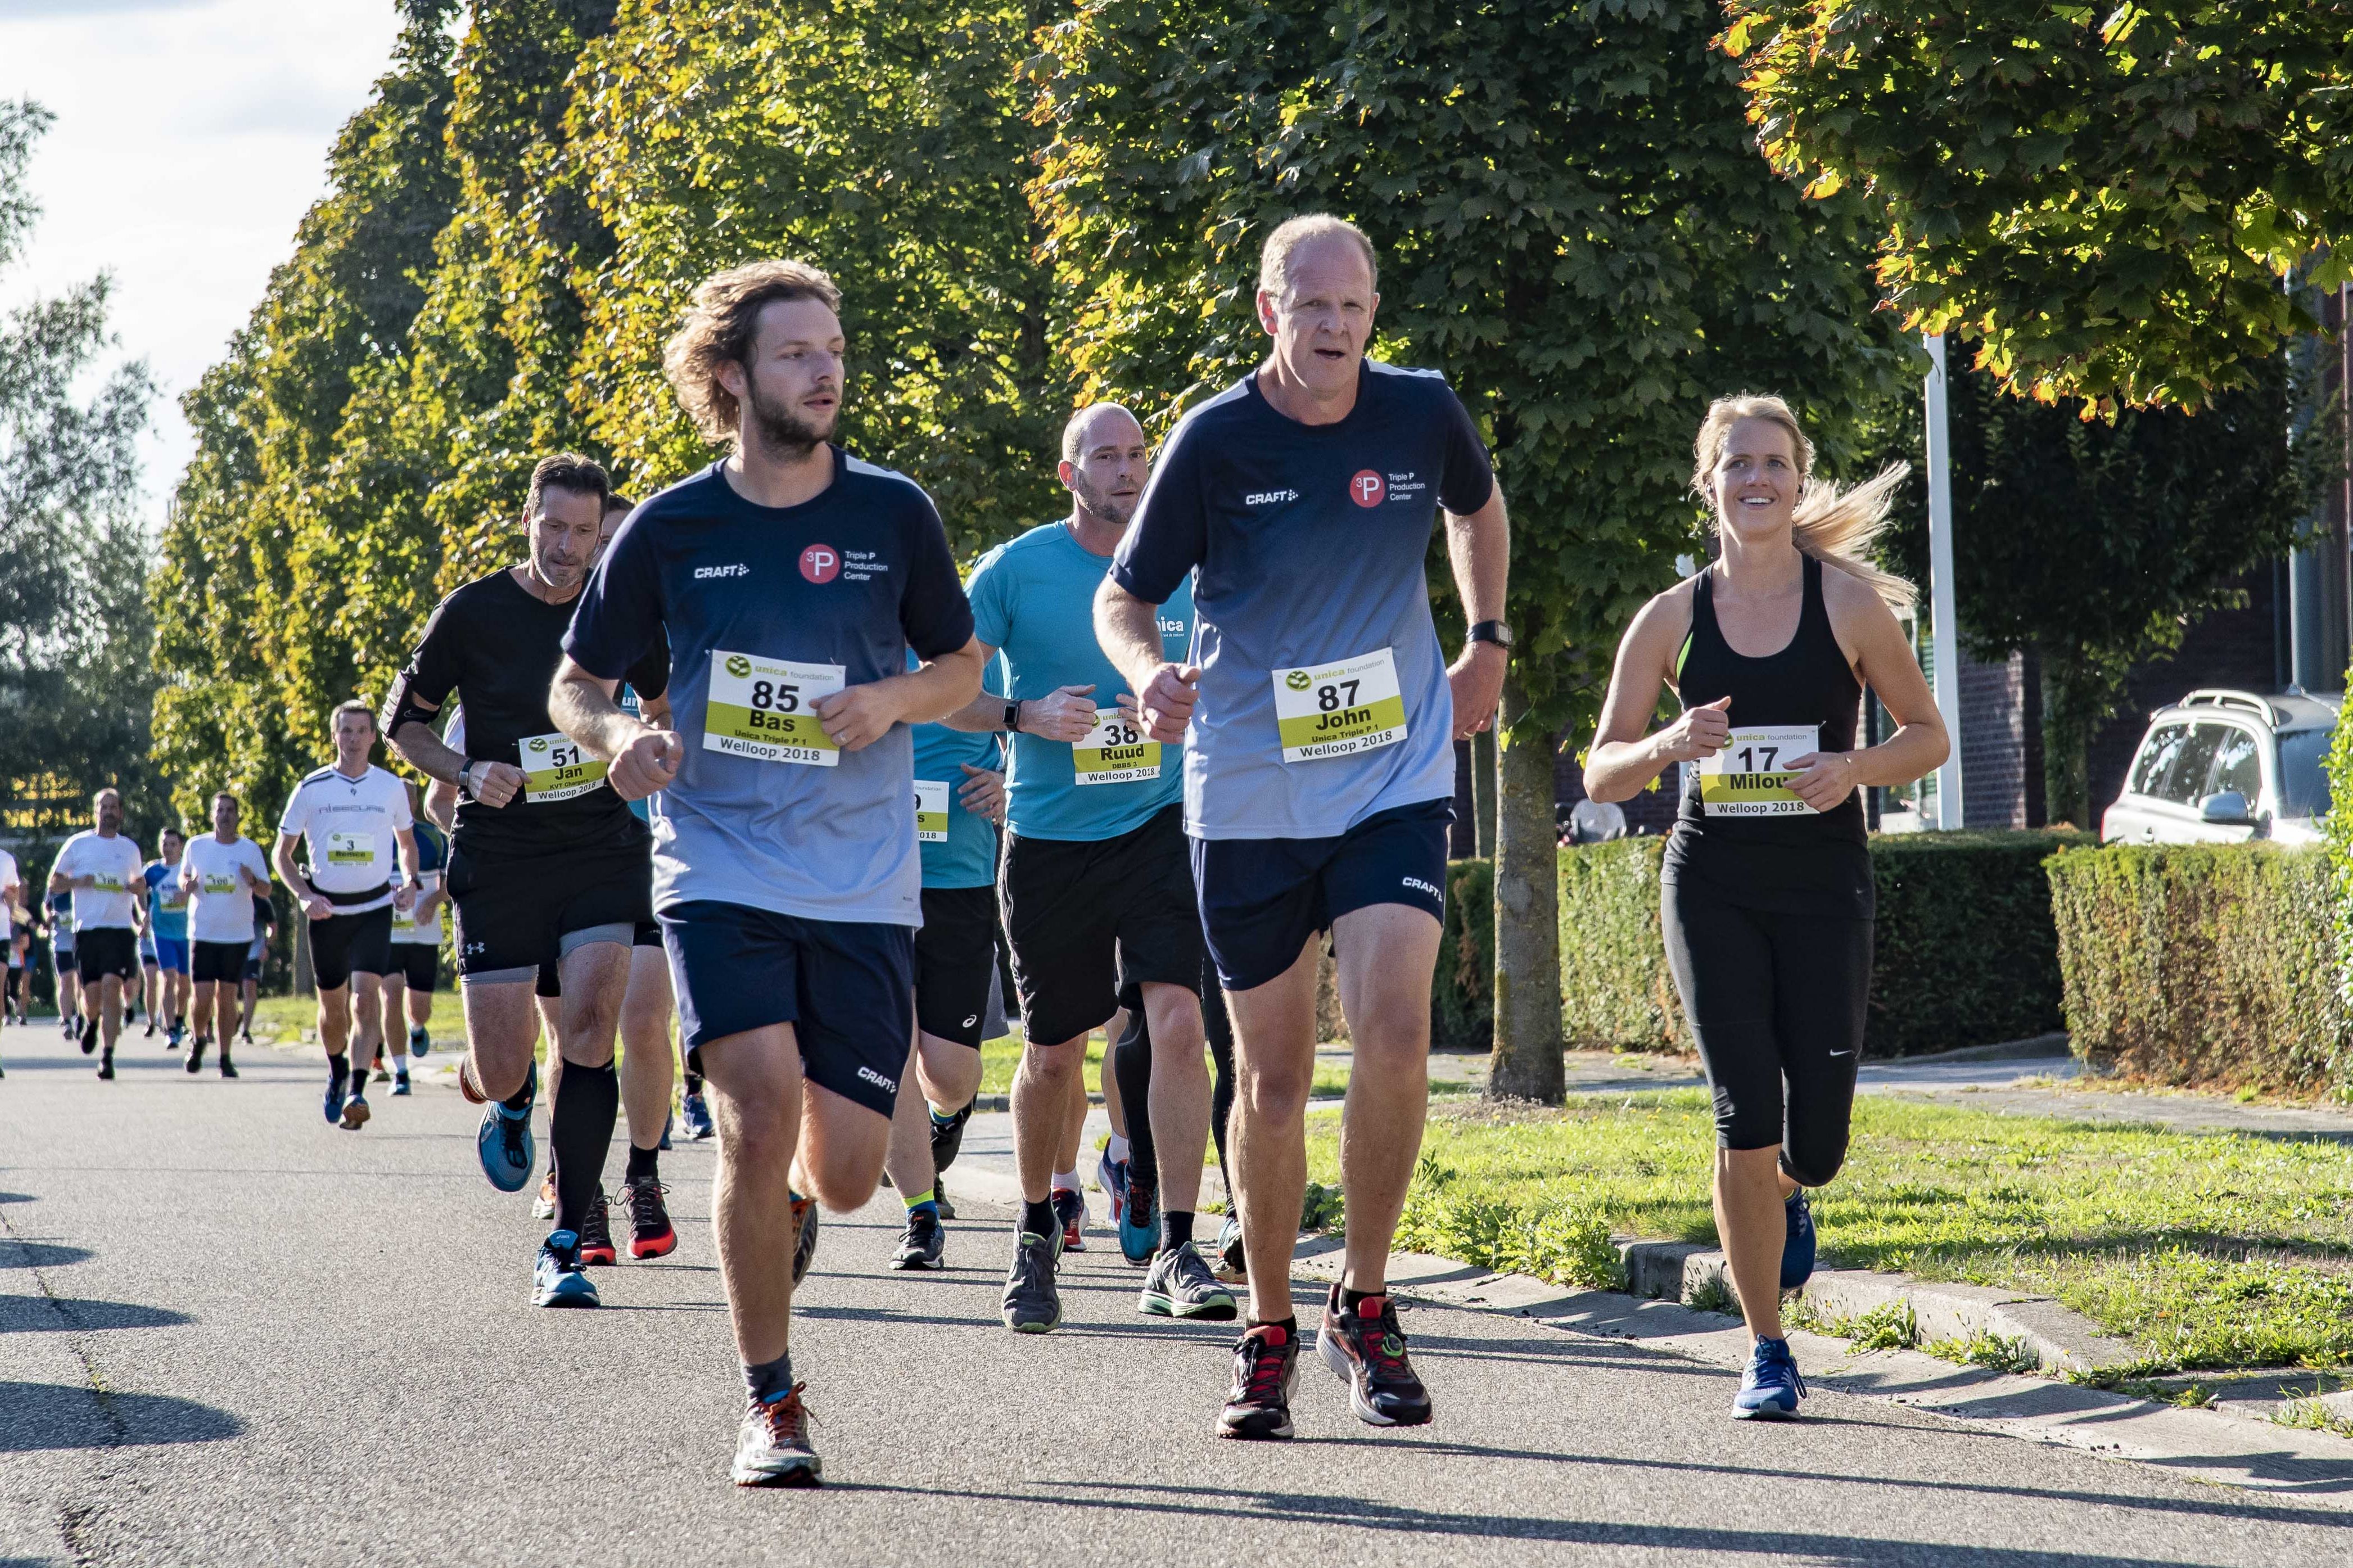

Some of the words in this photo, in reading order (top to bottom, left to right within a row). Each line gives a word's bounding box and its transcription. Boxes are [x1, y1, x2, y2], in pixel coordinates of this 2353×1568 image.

[1388, 473, 1407, 482] Triple
[1389, 482, 1425, 491] Production
[1245, 491, 1287, 505] CRAFT
[844, 551, 867, 560] Triple
[694, 565, 737, 579] CRAFT
[844, 562, 888, 572] Production
[844, 572, 871, 581] Center
[755, 666, 787, 676] unica
[791, 671, 834, 681] foundation
[1315, 669, 1345, 680] unica
[1347, 659, 1384, 674] foundation
[752, 680, 800, 712] 85
[1318, 679, 1360, 712] 87
[749, 709, 796, 732] Bas
[1316, 708, 1371, 730] John
[735, 729, 760, 740] Unica
[763, 733, 789, 744] Triple
[1104, 725, 1139, 746] 38
[1312, 734, 1337, 743] Unica
[1339, 727, 1364, 738] Triple
[1737, 733, 1765, 742] unica
[720, 738, 778, 759] Welloop
[783, 748, 820, 761] 2018
[1300, 742, 1357, 757] Welloop
[1361, 730, 1393, 748] 2018
[552, 745, 580, 767] 51
[1100, 744, 1145, 761] Ruud
[1738, 747, 1779, 772] 17
[554, 767, 583, 780] Jan
[1088, 771, 1132, 781] Welloop
[1136, 767, 1155, 778] 2018
[538, 789, 577, 799] Welloop
[579, 781, 597, 793] 2018
[564, 779, 590, 787] Chargers
[1730, 774, 1789, 790] Milou
[1717, 803, 1768, 815] Welloop
[1772, 802, 1805, 812] 2018
[1402, 876, 1439, 897] CRAFT
[858, 1067, 892, 1090] CRAFT
